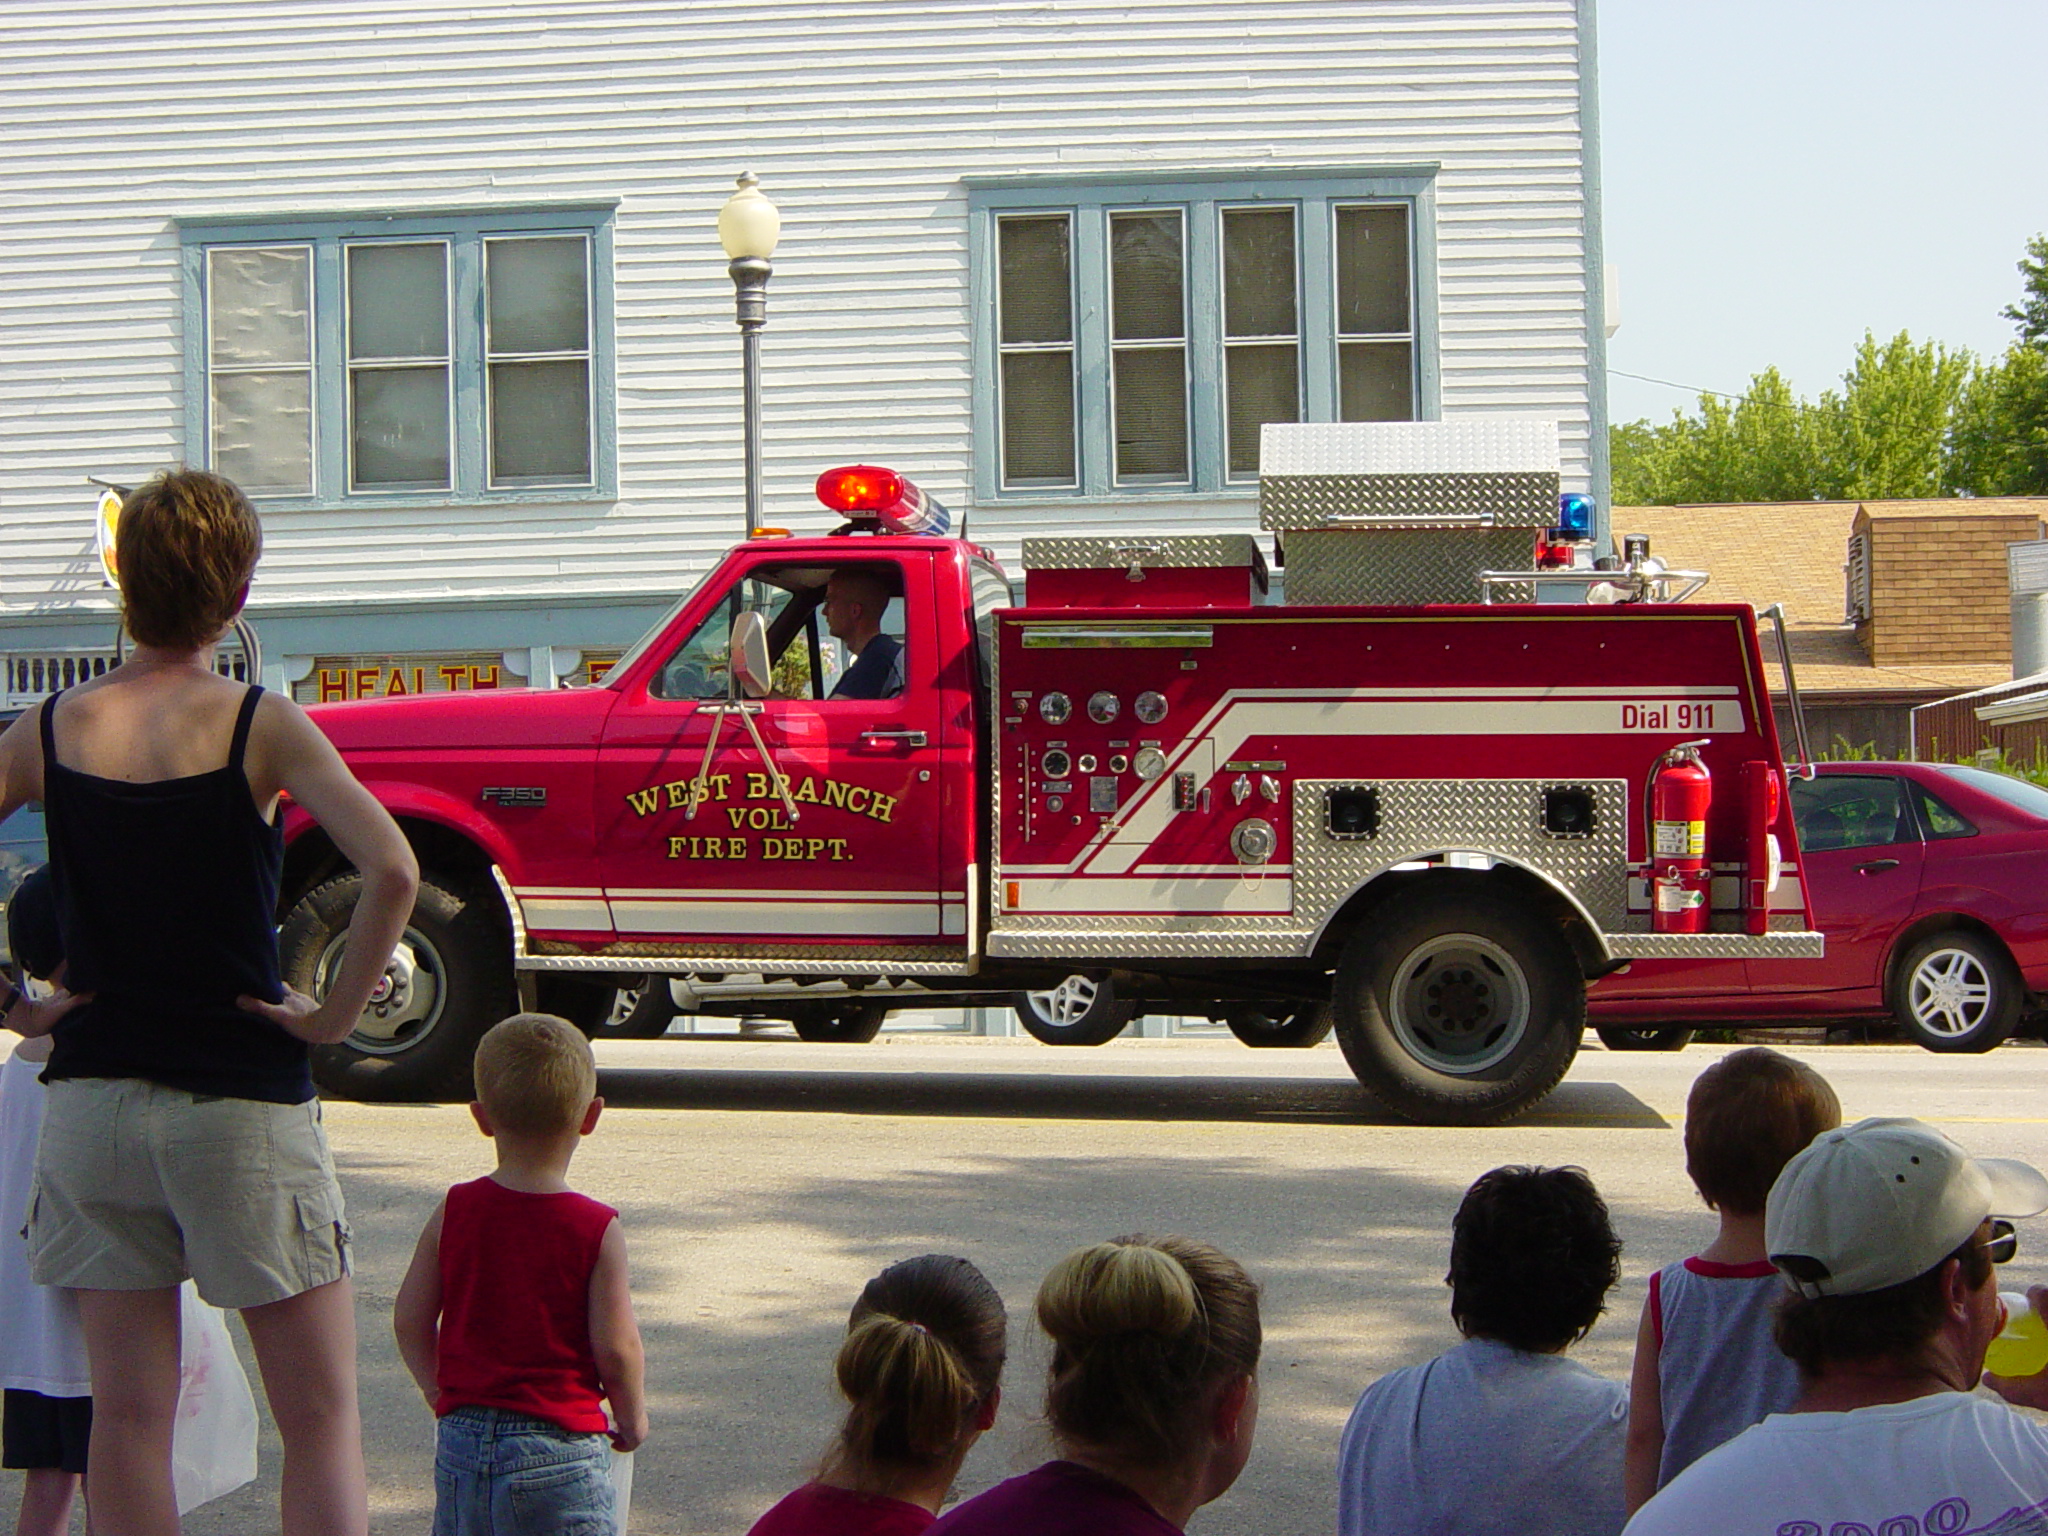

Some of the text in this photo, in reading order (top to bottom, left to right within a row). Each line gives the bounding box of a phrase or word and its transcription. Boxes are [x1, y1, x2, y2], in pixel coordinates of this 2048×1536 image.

[318, 664, 501, 703] HEALTH
[1622, 704, 1714, 729] Dial 911
[482, 787, 547, 801] F350
[626, 772, 897, 823] WEST BRANCH
[727, 807, 795, 831] VOL.
[668, 836, 854, 860] FIRE DEPT.
